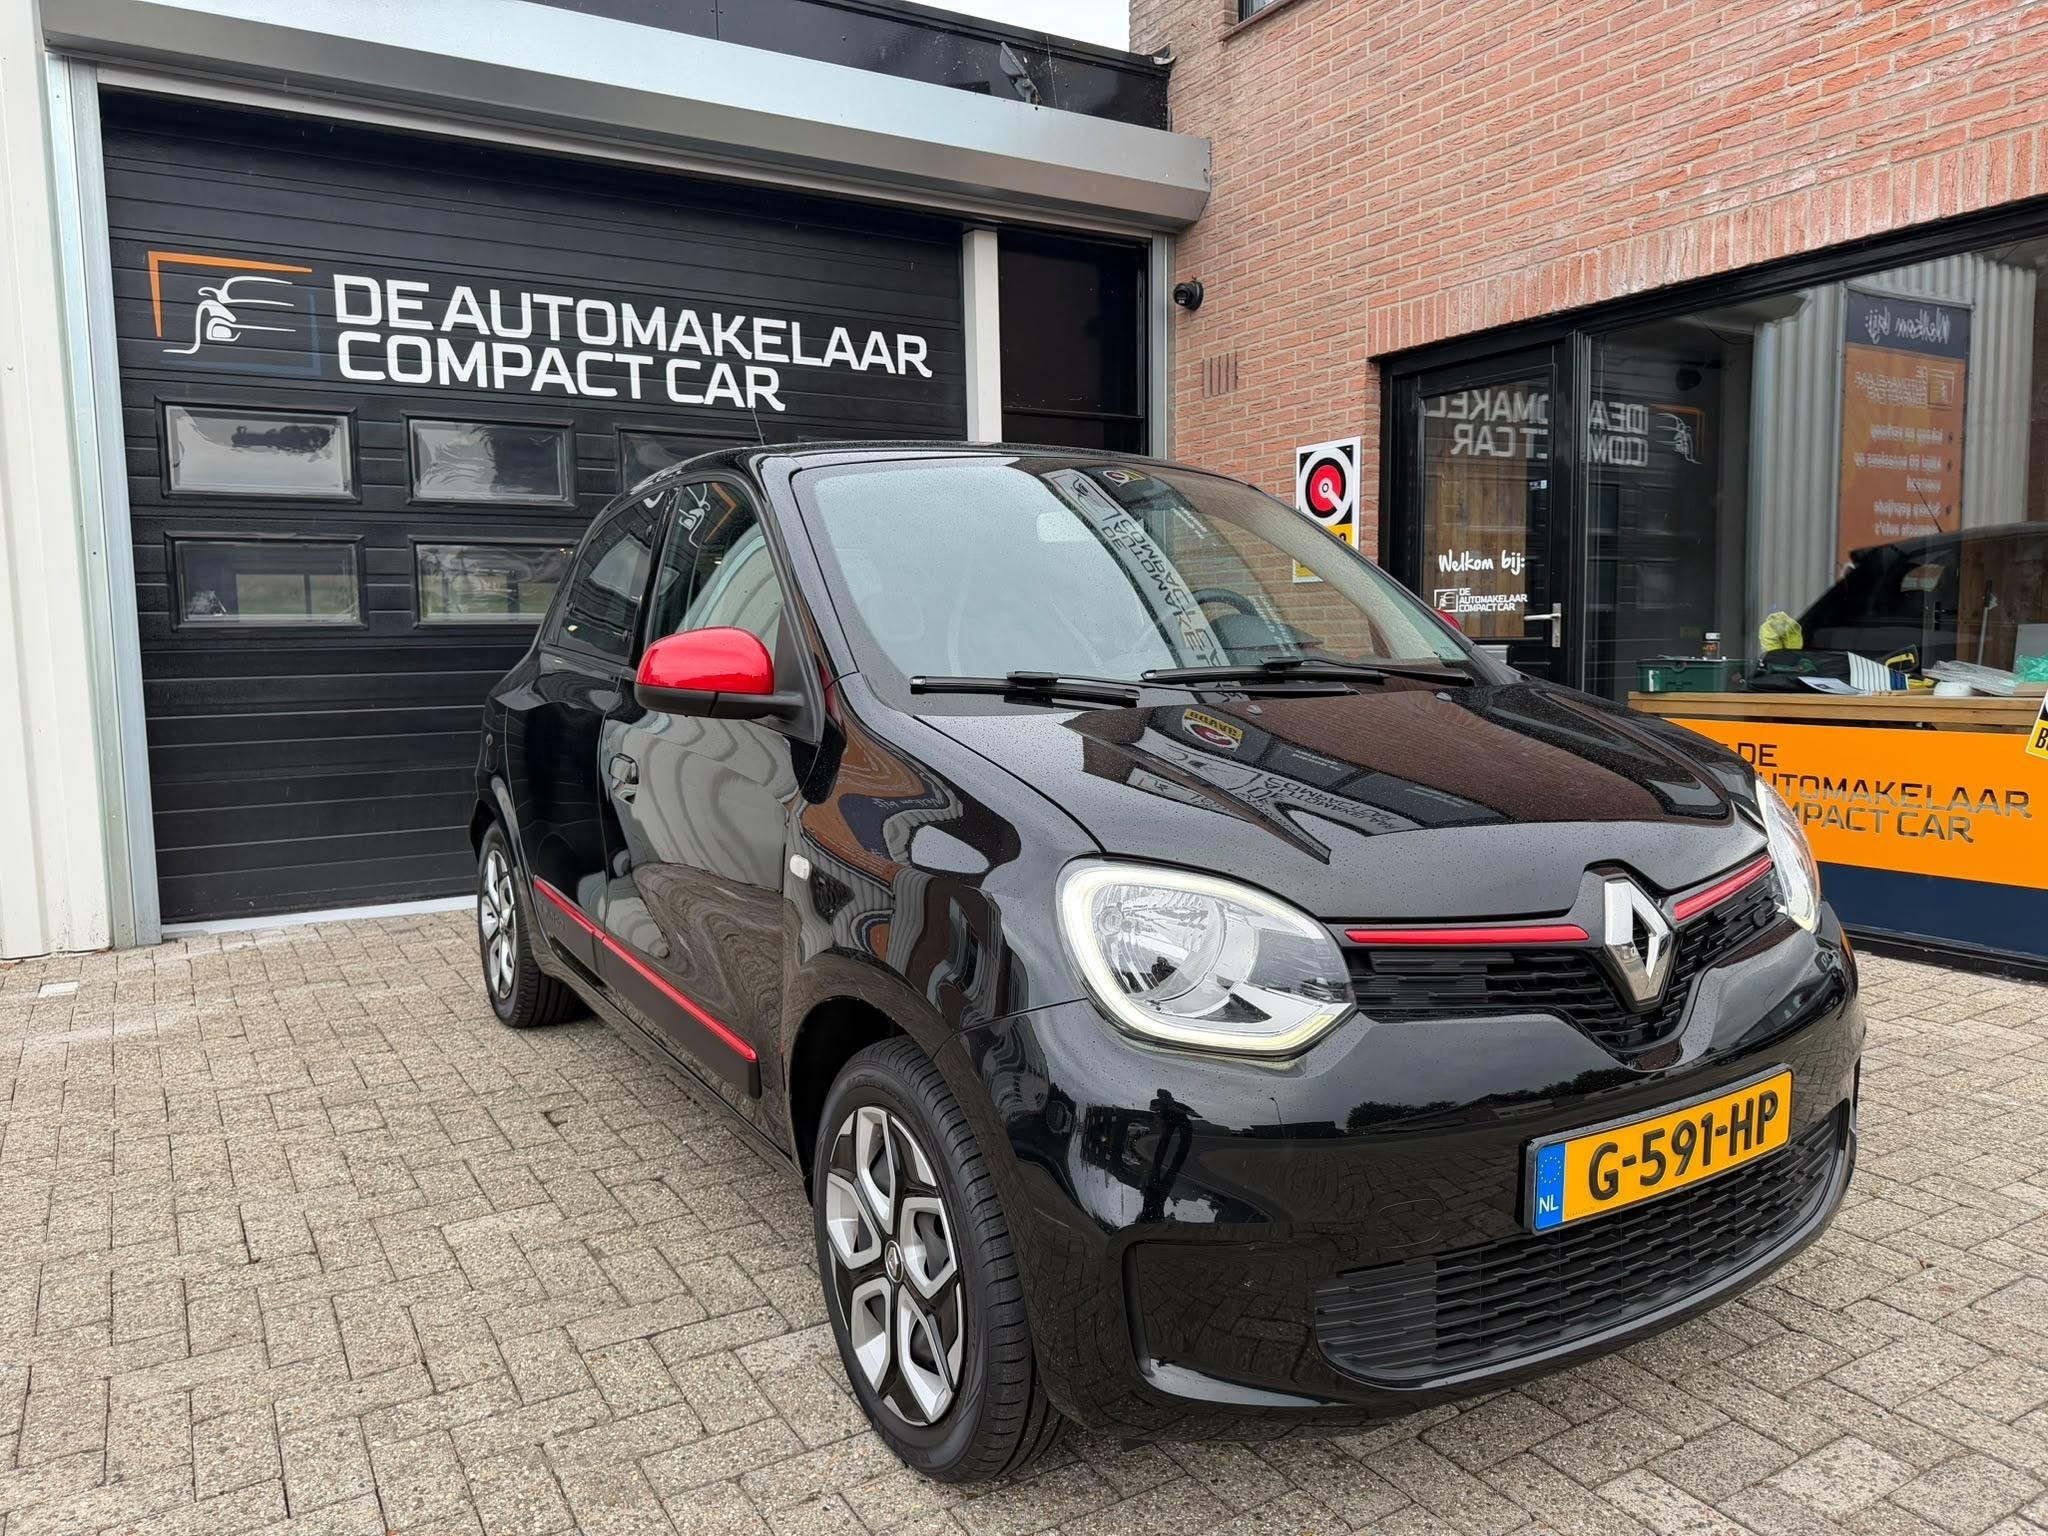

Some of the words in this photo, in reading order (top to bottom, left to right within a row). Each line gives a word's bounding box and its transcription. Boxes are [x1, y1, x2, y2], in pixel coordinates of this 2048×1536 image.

[333, 274, 434, 331] DE
[440, 285, 933, 378] AUTOMAKELAAR
[338, 331, 654, 400] COMPACT
[666, 358, 786, 412] CAR
[1439, 549, 1494, 572] Welkom
[1501, 550, 1526, 576] bij:
[1459, 588, 1472, 596] DE
[1459, 594, 1528, 604] AUTOMAKELAAR
[1459, 603, 1497, 612] COMPACT
[1498, 603, 1516, 612] CAR
[1738, 742, 1778, 767] DE
[1759, 771, 2033, 818] UTOMAKELAAR
[1896, 812, 1974, 843] CAR
[1588, 1089, 1779, 1201] G-591-HP
[1538, 1193, 1559, 1214] NL
